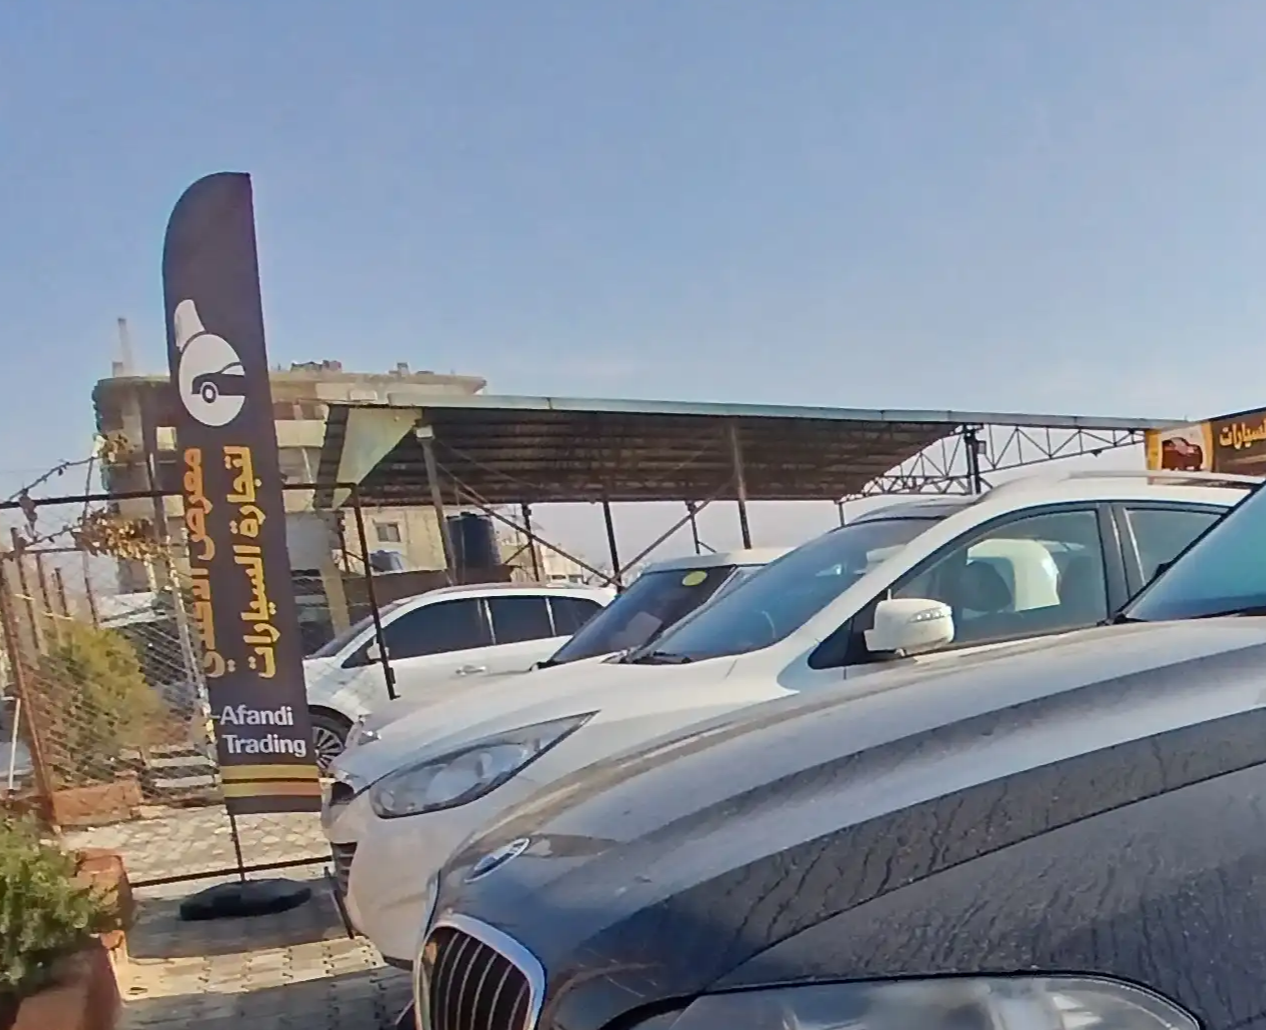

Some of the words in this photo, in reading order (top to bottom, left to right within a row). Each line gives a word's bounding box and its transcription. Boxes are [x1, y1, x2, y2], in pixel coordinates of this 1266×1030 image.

[223, 446, 266, 537] لتجارة
[232, 545, 281, 679] السيارات
[222, 734, 307, 758] Trading
